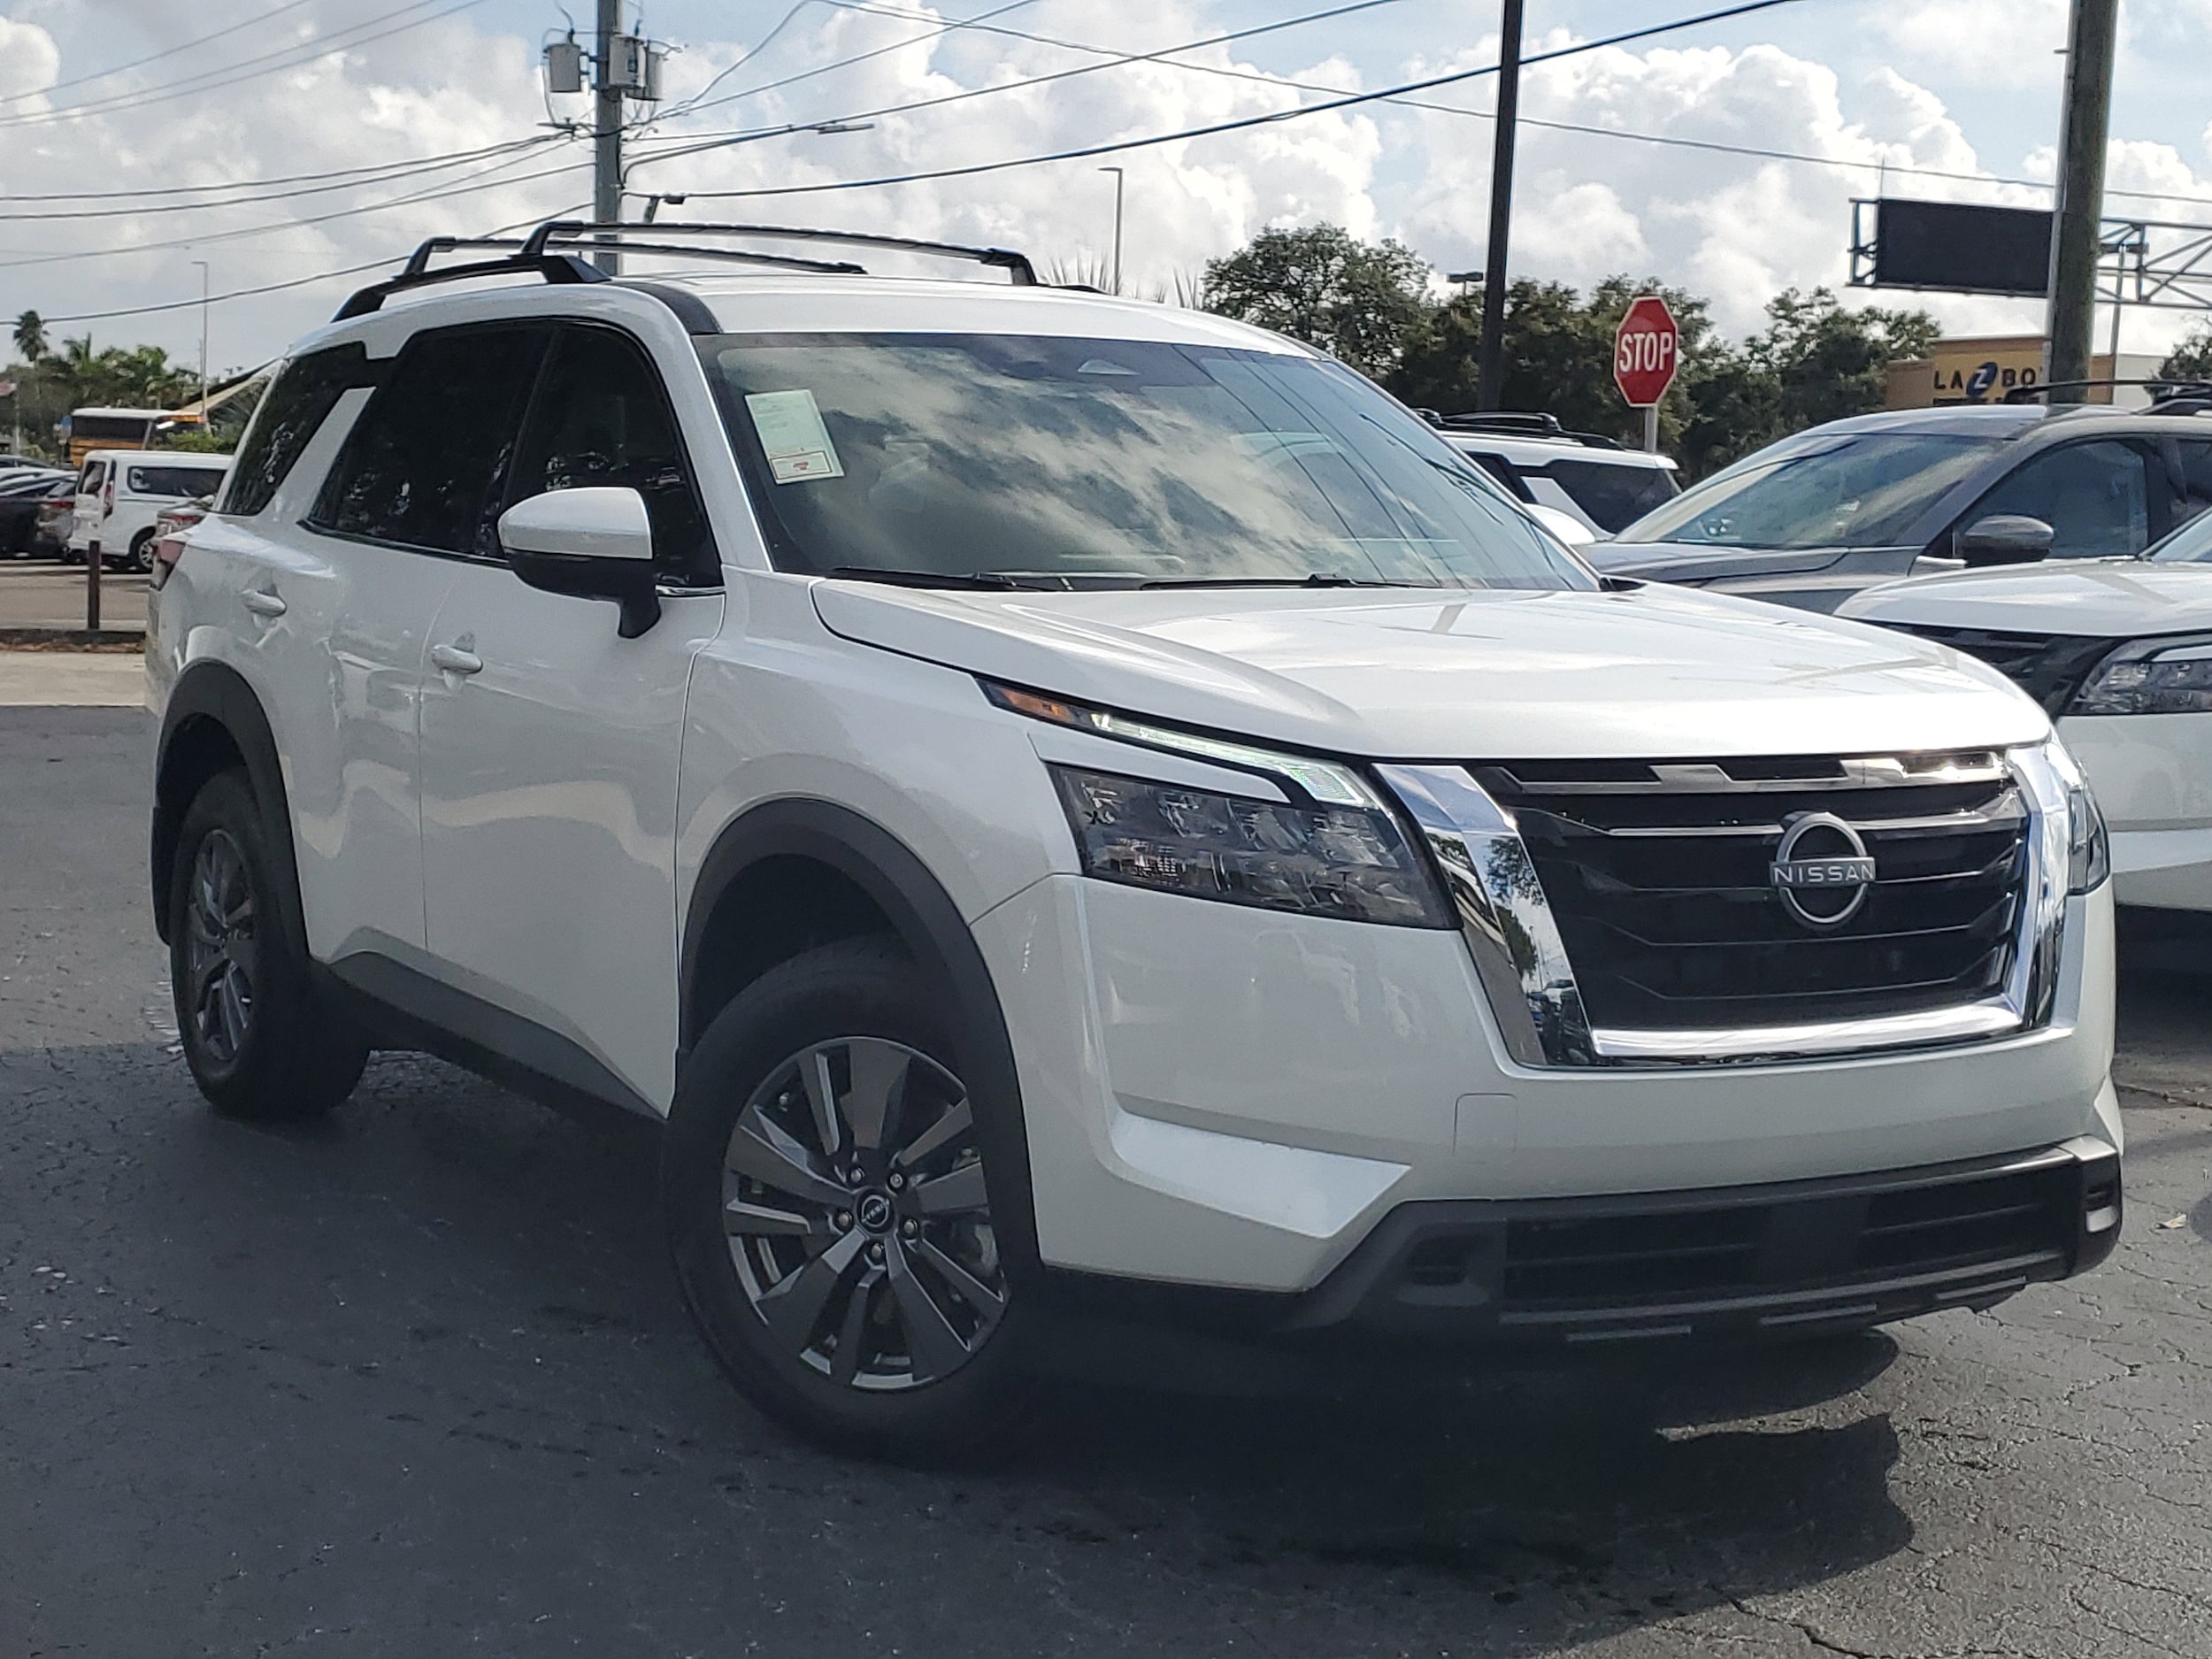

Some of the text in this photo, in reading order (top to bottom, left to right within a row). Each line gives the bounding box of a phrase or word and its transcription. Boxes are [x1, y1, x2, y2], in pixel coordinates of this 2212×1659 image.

[1619, 332, 1673, 372] STOP
[2001, 366, 2042, 387] BO
[1774, 864, 1874, 883] NISSAN
